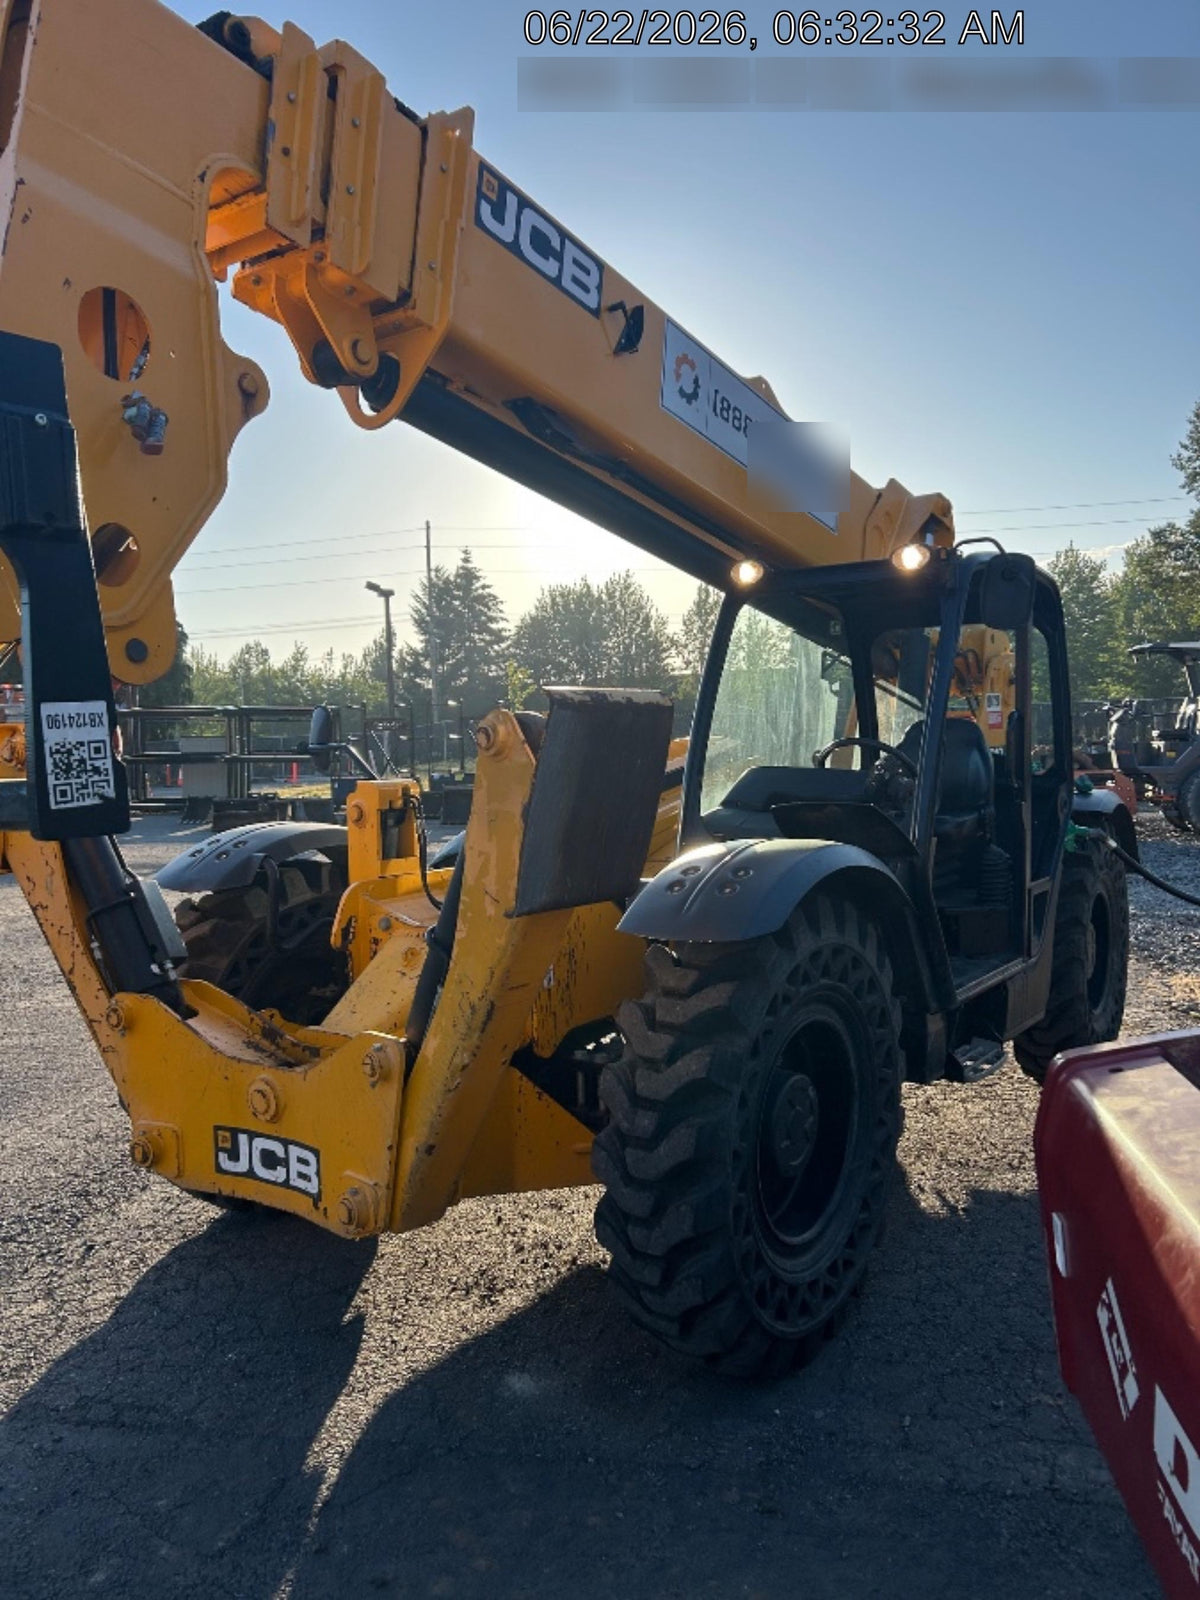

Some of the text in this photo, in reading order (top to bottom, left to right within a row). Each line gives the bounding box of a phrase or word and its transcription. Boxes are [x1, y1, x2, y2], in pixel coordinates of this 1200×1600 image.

[479, 193, 601, 311] JCB
[46, 711, 105, 730] XB124190
[218, 1132, 319, 1194] JCB
